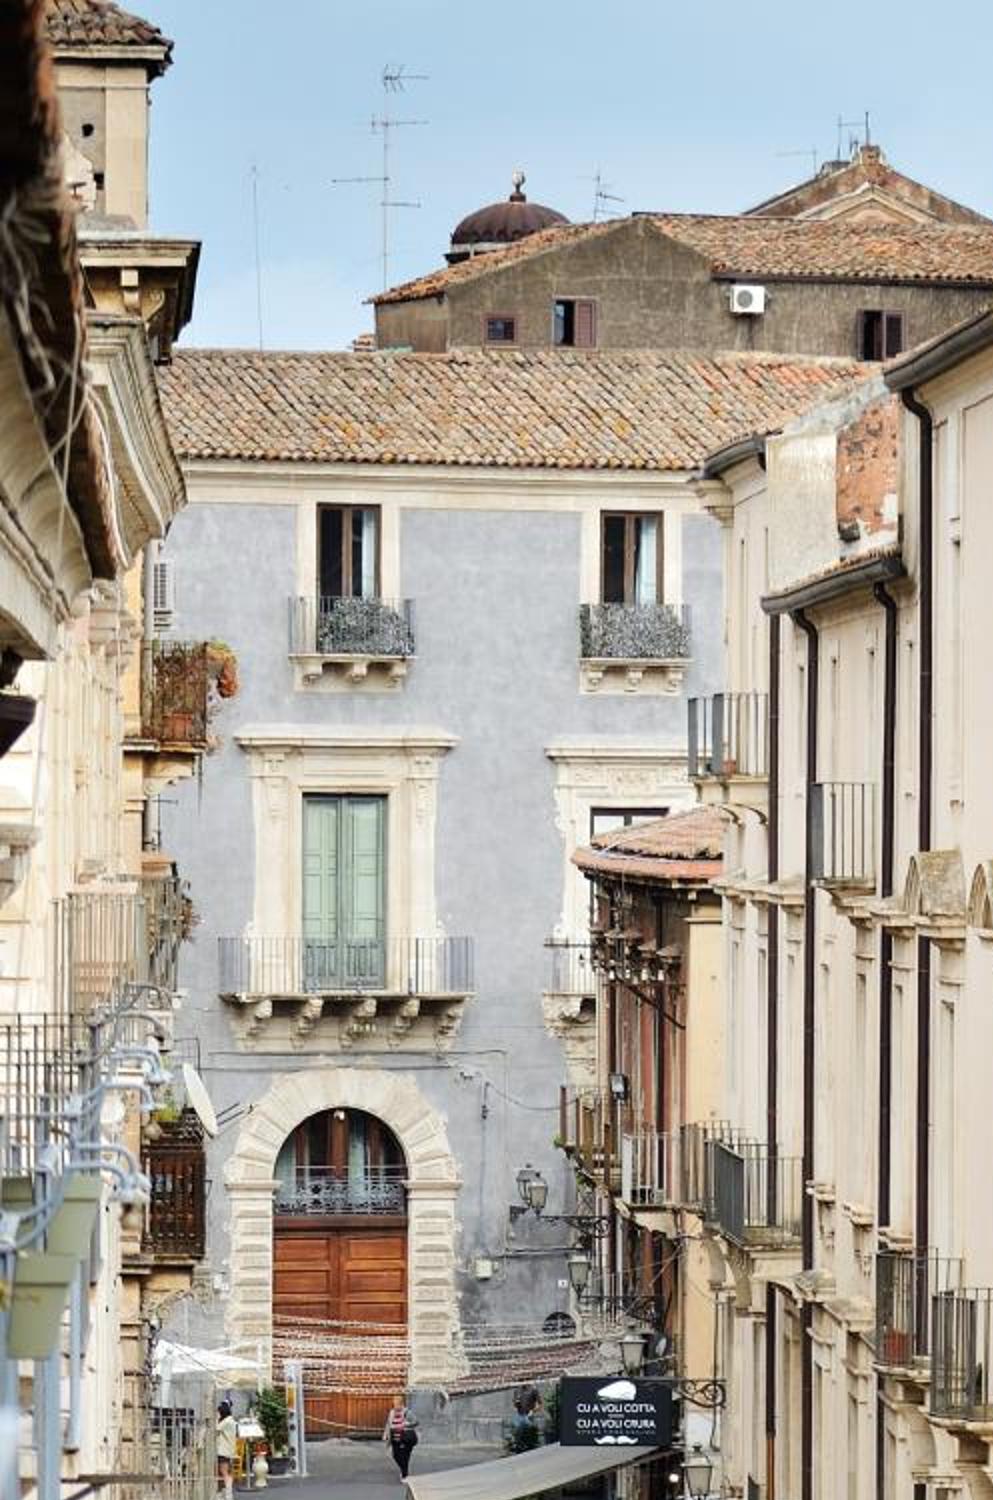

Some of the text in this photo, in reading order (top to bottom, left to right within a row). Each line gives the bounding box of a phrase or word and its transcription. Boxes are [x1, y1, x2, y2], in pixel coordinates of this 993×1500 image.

[576, 1403, 656, 1413] CU A VOLI COTTA
[576, 1419, 590, 1428] CU
[592, 1419, 600, 1429] A
[601, 1419, 622, 1429] VOLI
